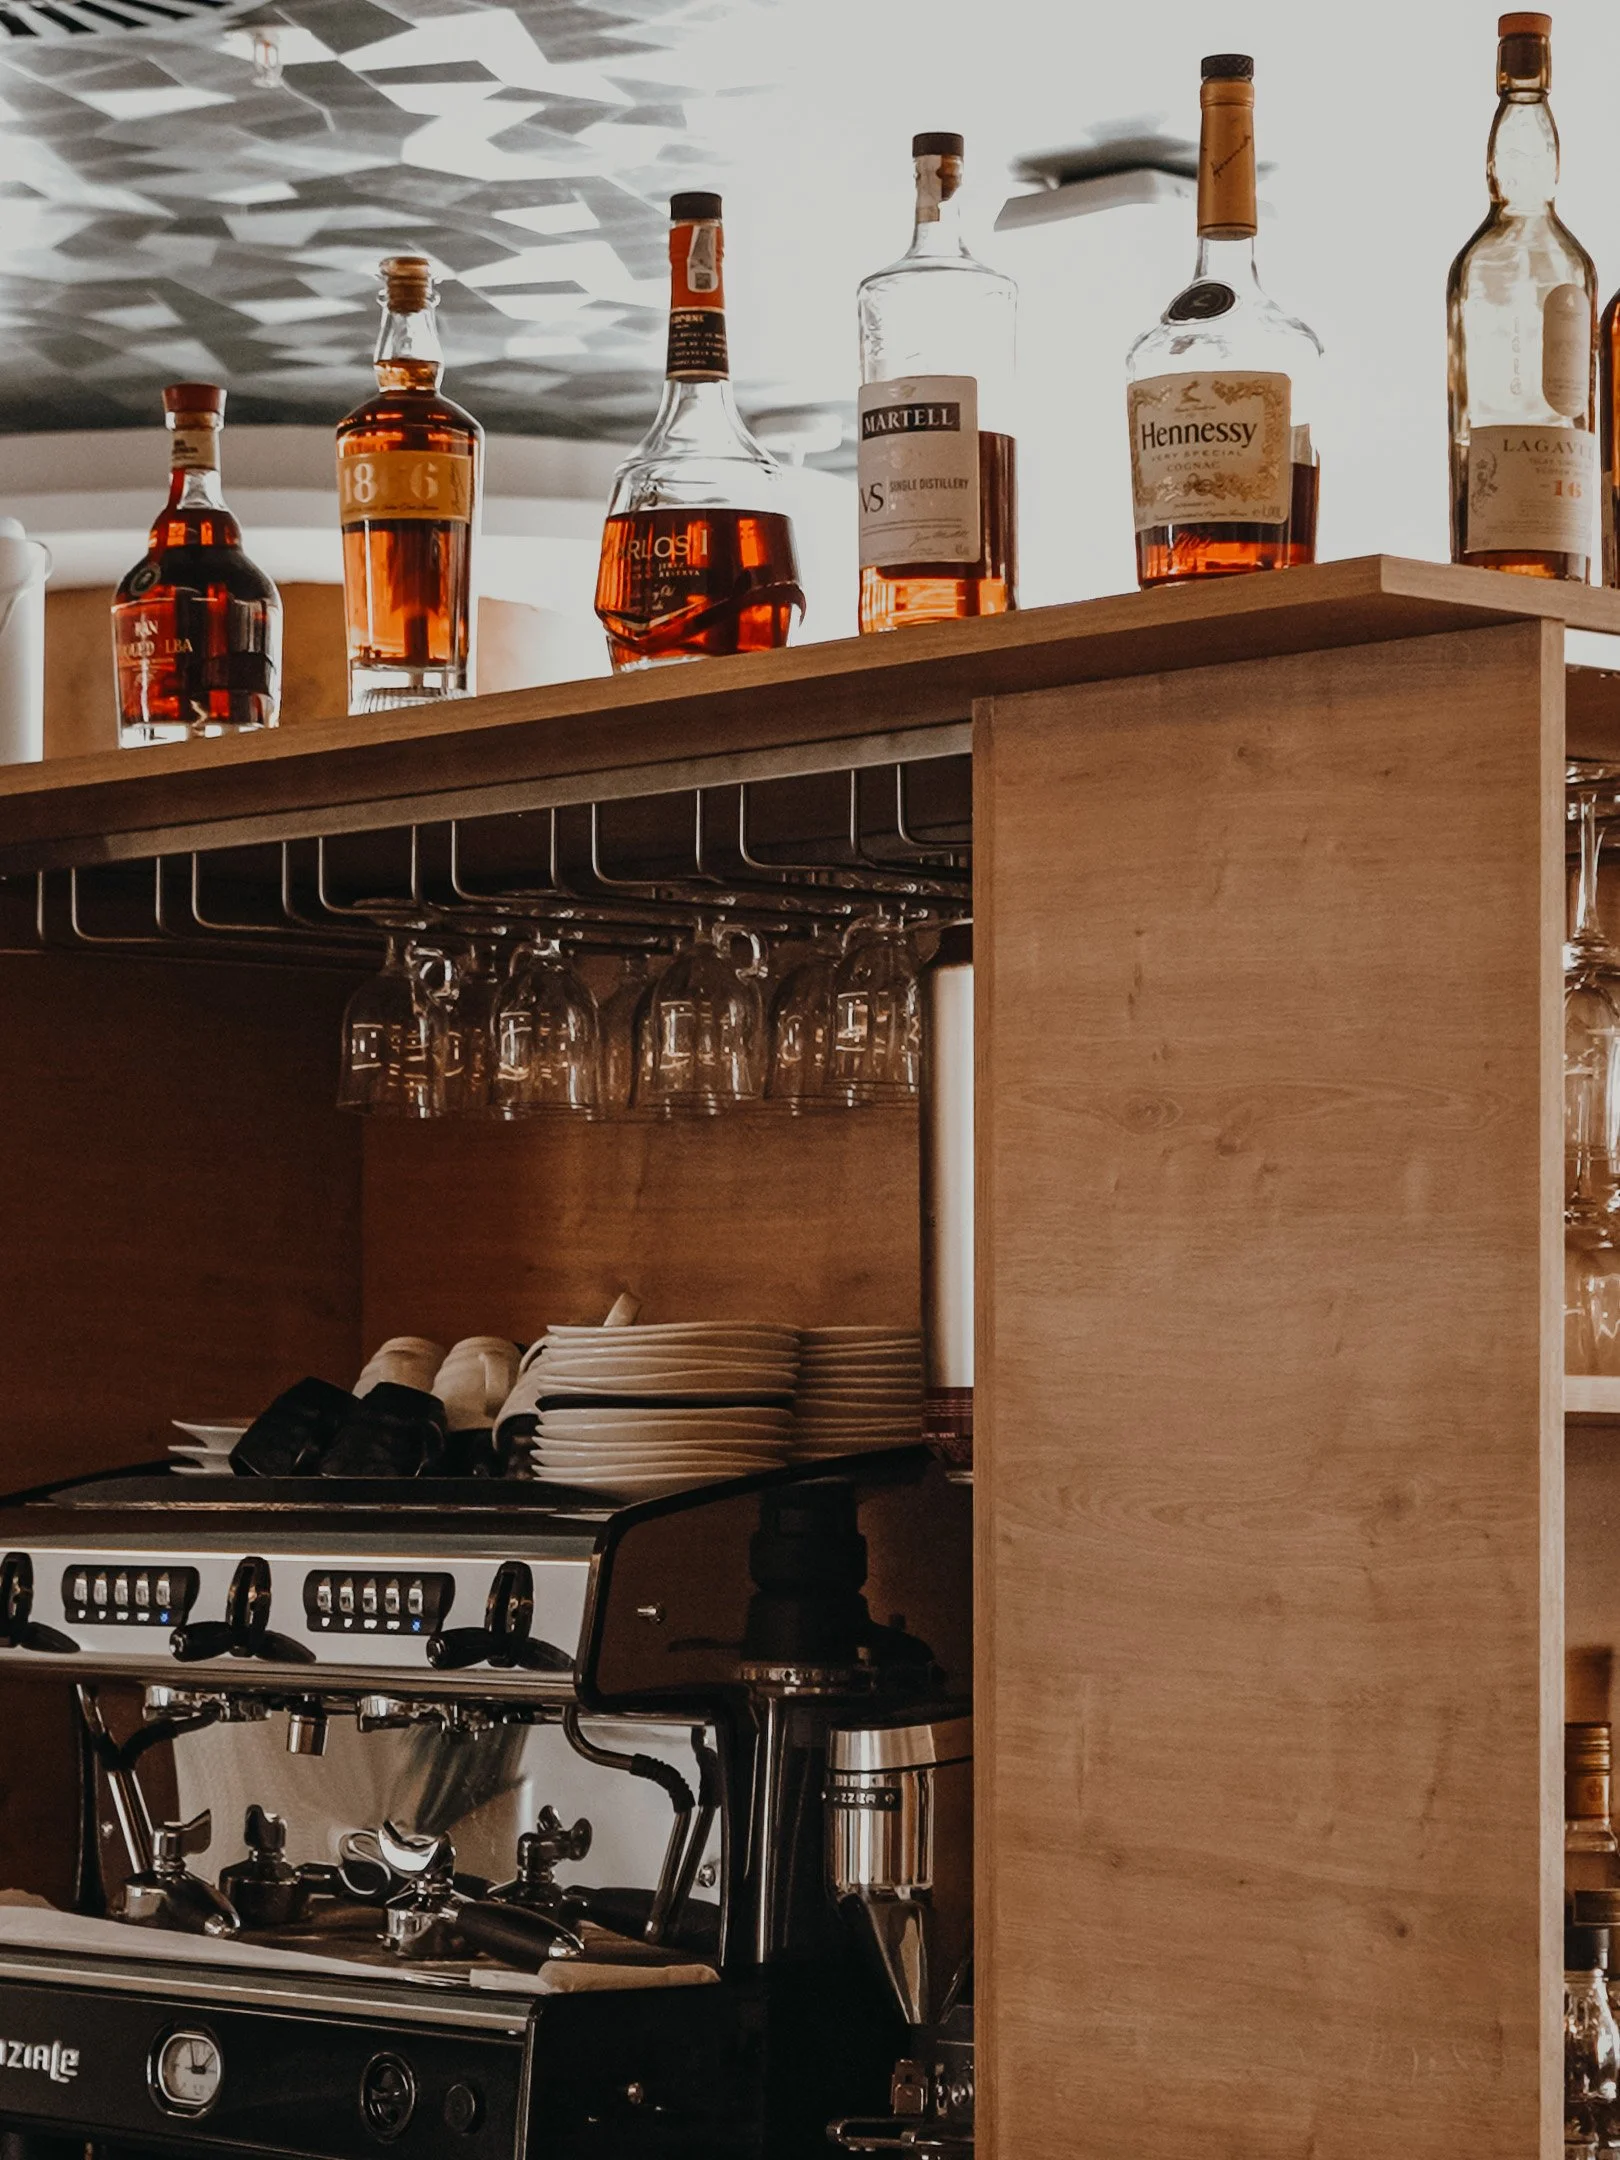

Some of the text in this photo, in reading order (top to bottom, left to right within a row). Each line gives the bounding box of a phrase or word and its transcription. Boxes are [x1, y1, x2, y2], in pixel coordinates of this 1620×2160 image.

[864, 407, 954, 433] MARTELL
[1141, 421, 1258, 450] Hennessy
[1167, 461, 1221, 473] COGNAC
[890, 478, 969, 492] SINGLE DISTILLERY
[1555, 480, 1582, 498] 16
[860, 482, 884, 513] VS
